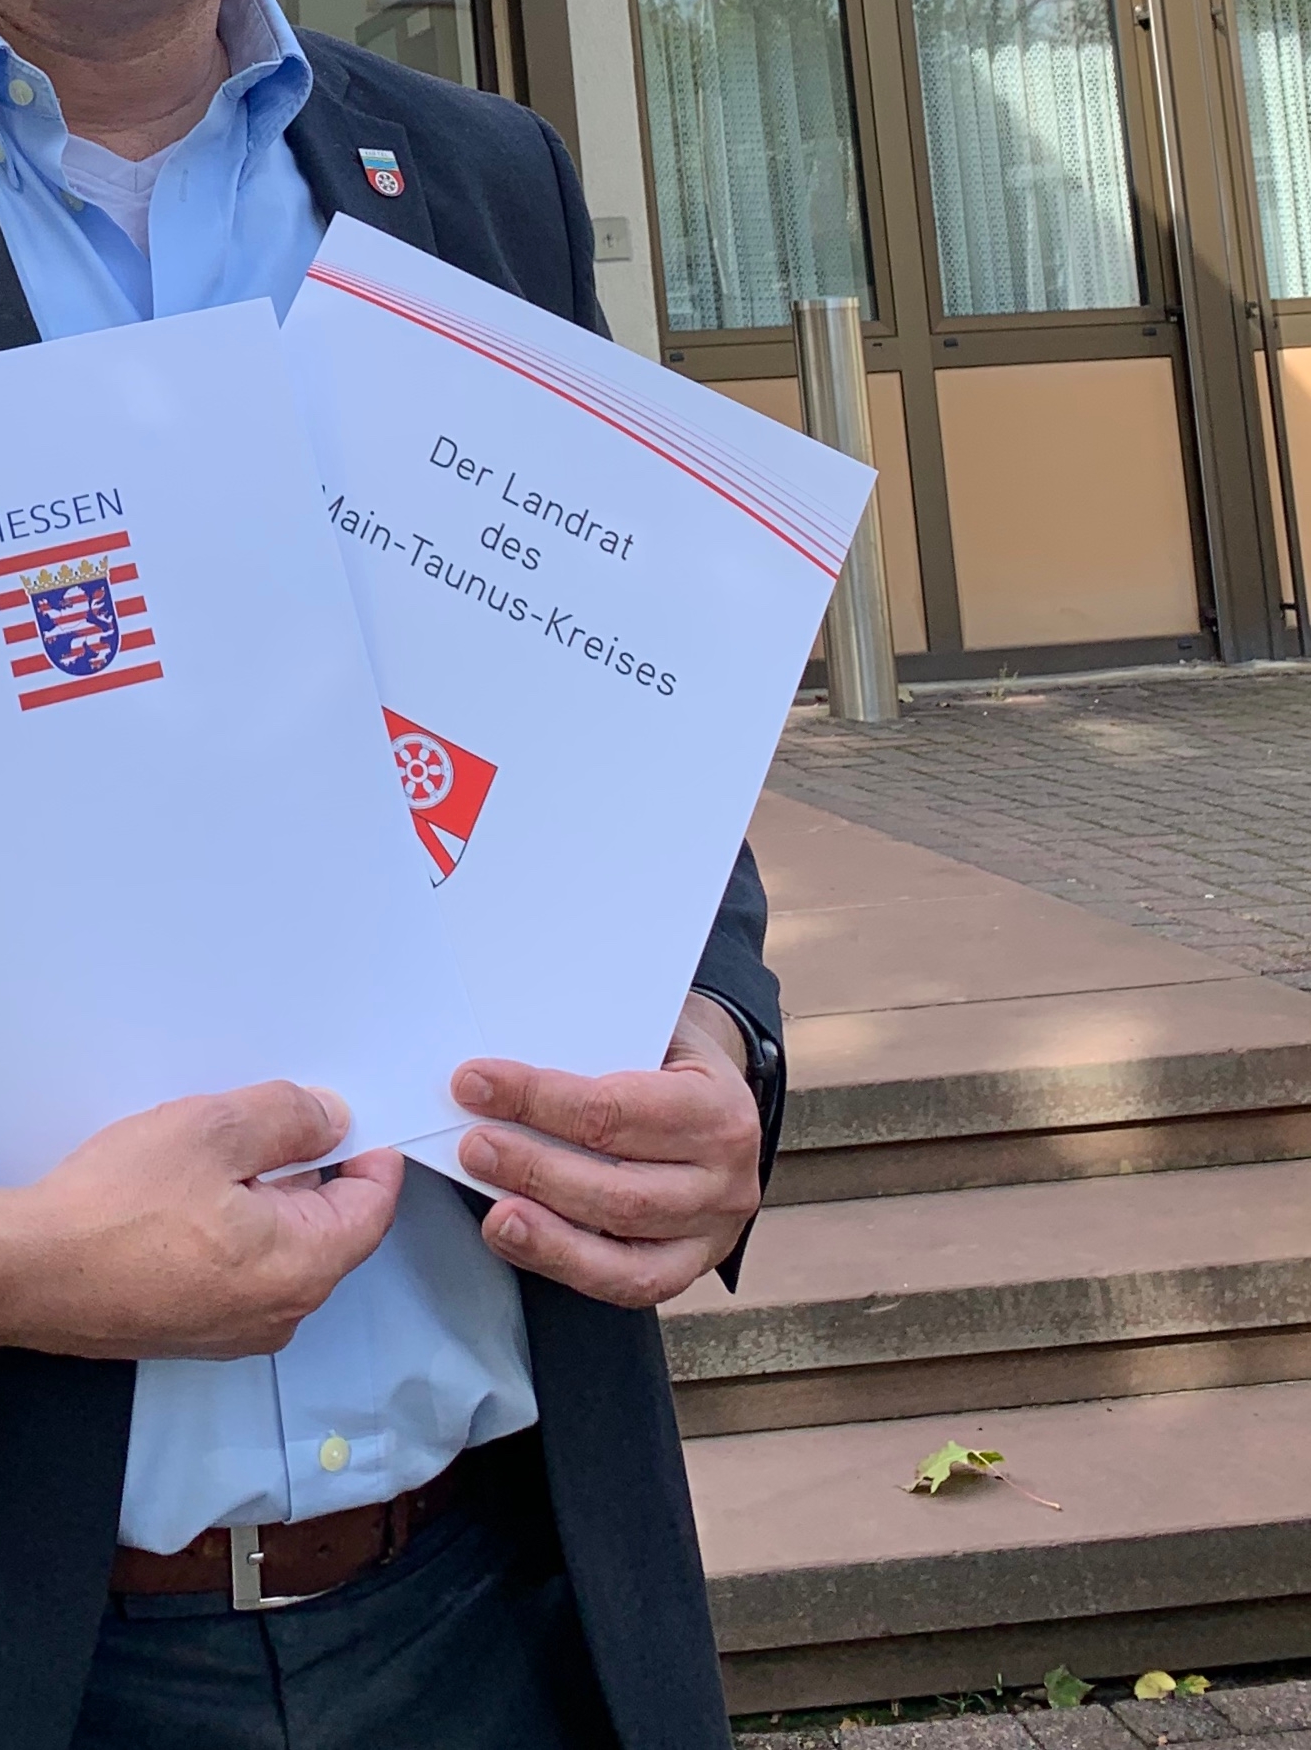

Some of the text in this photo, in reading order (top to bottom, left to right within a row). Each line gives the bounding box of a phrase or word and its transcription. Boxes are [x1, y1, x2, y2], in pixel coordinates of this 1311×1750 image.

[429, 436, 635, 561] Der Landrat
[480, 523, 542, 571] des
